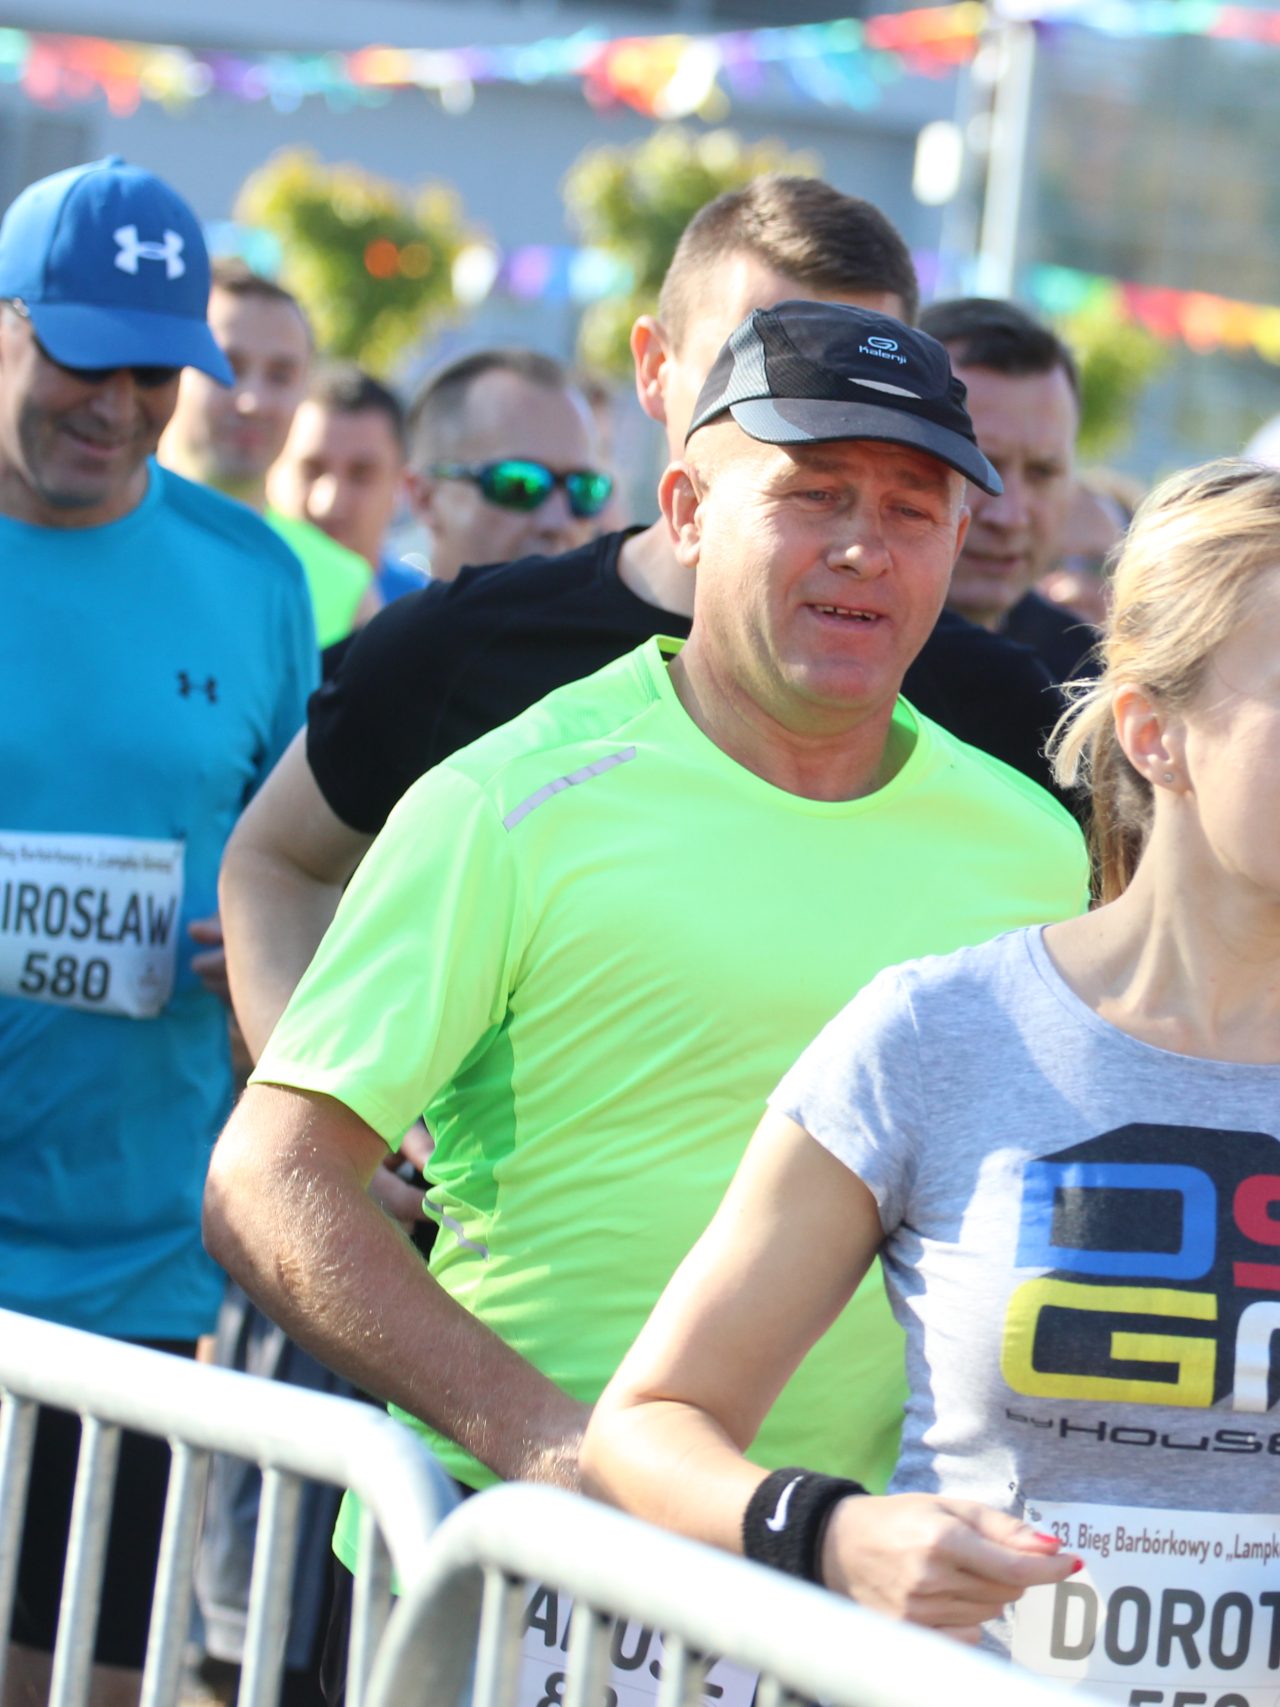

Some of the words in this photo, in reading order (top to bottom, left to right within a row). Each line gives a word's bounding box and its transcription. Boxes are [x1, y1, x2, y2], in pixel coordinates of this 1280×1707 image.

[859, 345, 907, 364] Kalenji
[0, 880, 177, 946] IROSŁAW
[19, 952, 110, 1001] 580
[1006, 1409, 1053, 1428] by
[1078, 1523, 1111, 1558] Bieg
[1115, 1525, 1210, 1564] Barbórkowy
[1214, 1541, 1223, 1557] o
